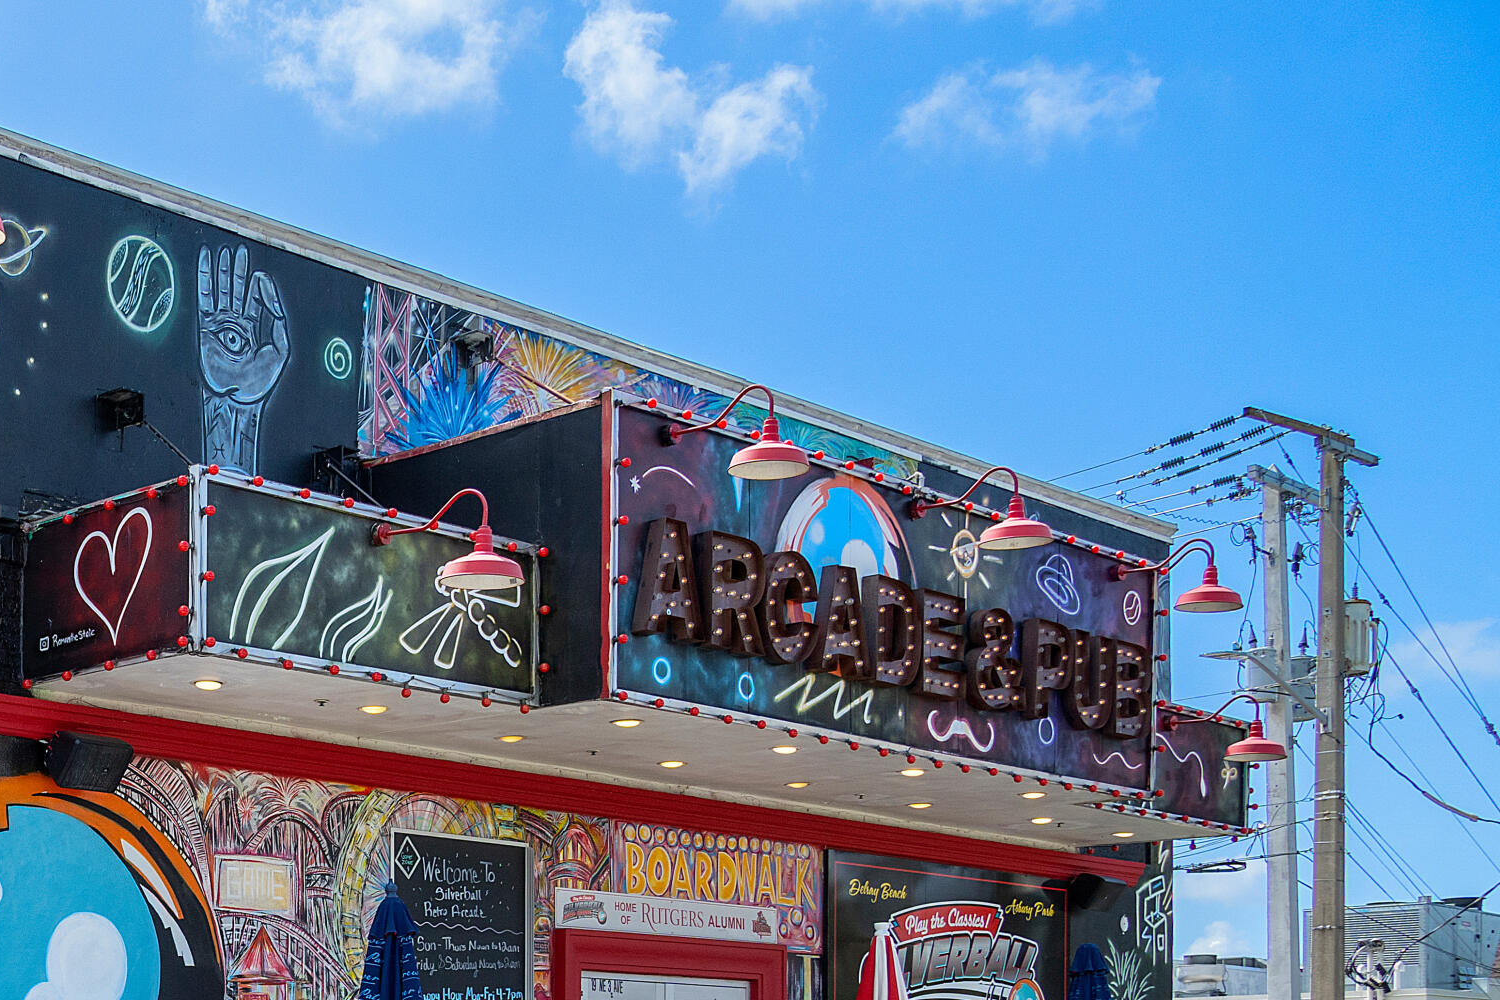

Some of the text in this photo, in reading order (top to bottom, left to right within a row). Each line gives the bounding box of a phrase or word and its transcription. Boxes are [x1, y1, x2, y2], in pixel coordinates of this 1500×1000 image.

[422, 856, 496, 885] Welcome To
[625, 842, 816, 911] BOARDWALK
[435, 886, 482, 901] Silverball
[849, 878, 908, 904] Delray Beach
[423, 901, 487, 918] Retro Arcade
[614, 901, 637, 913] HOME
[641, 902, 704, 932] RUTGERS
[708, 915, 745, 931] ALUMNI
[1005, 899, 1055, 921] Asbury Park
[620, 915, 632, 925] OF
[905, 907, 991, 936] Play the Classics!
[415, 956, 438, 976] ridy
[899, 932, 1039, 988] LVERBALL
[599, 979, 606, 992] NE
[614, 979, 623, 994] AVE
